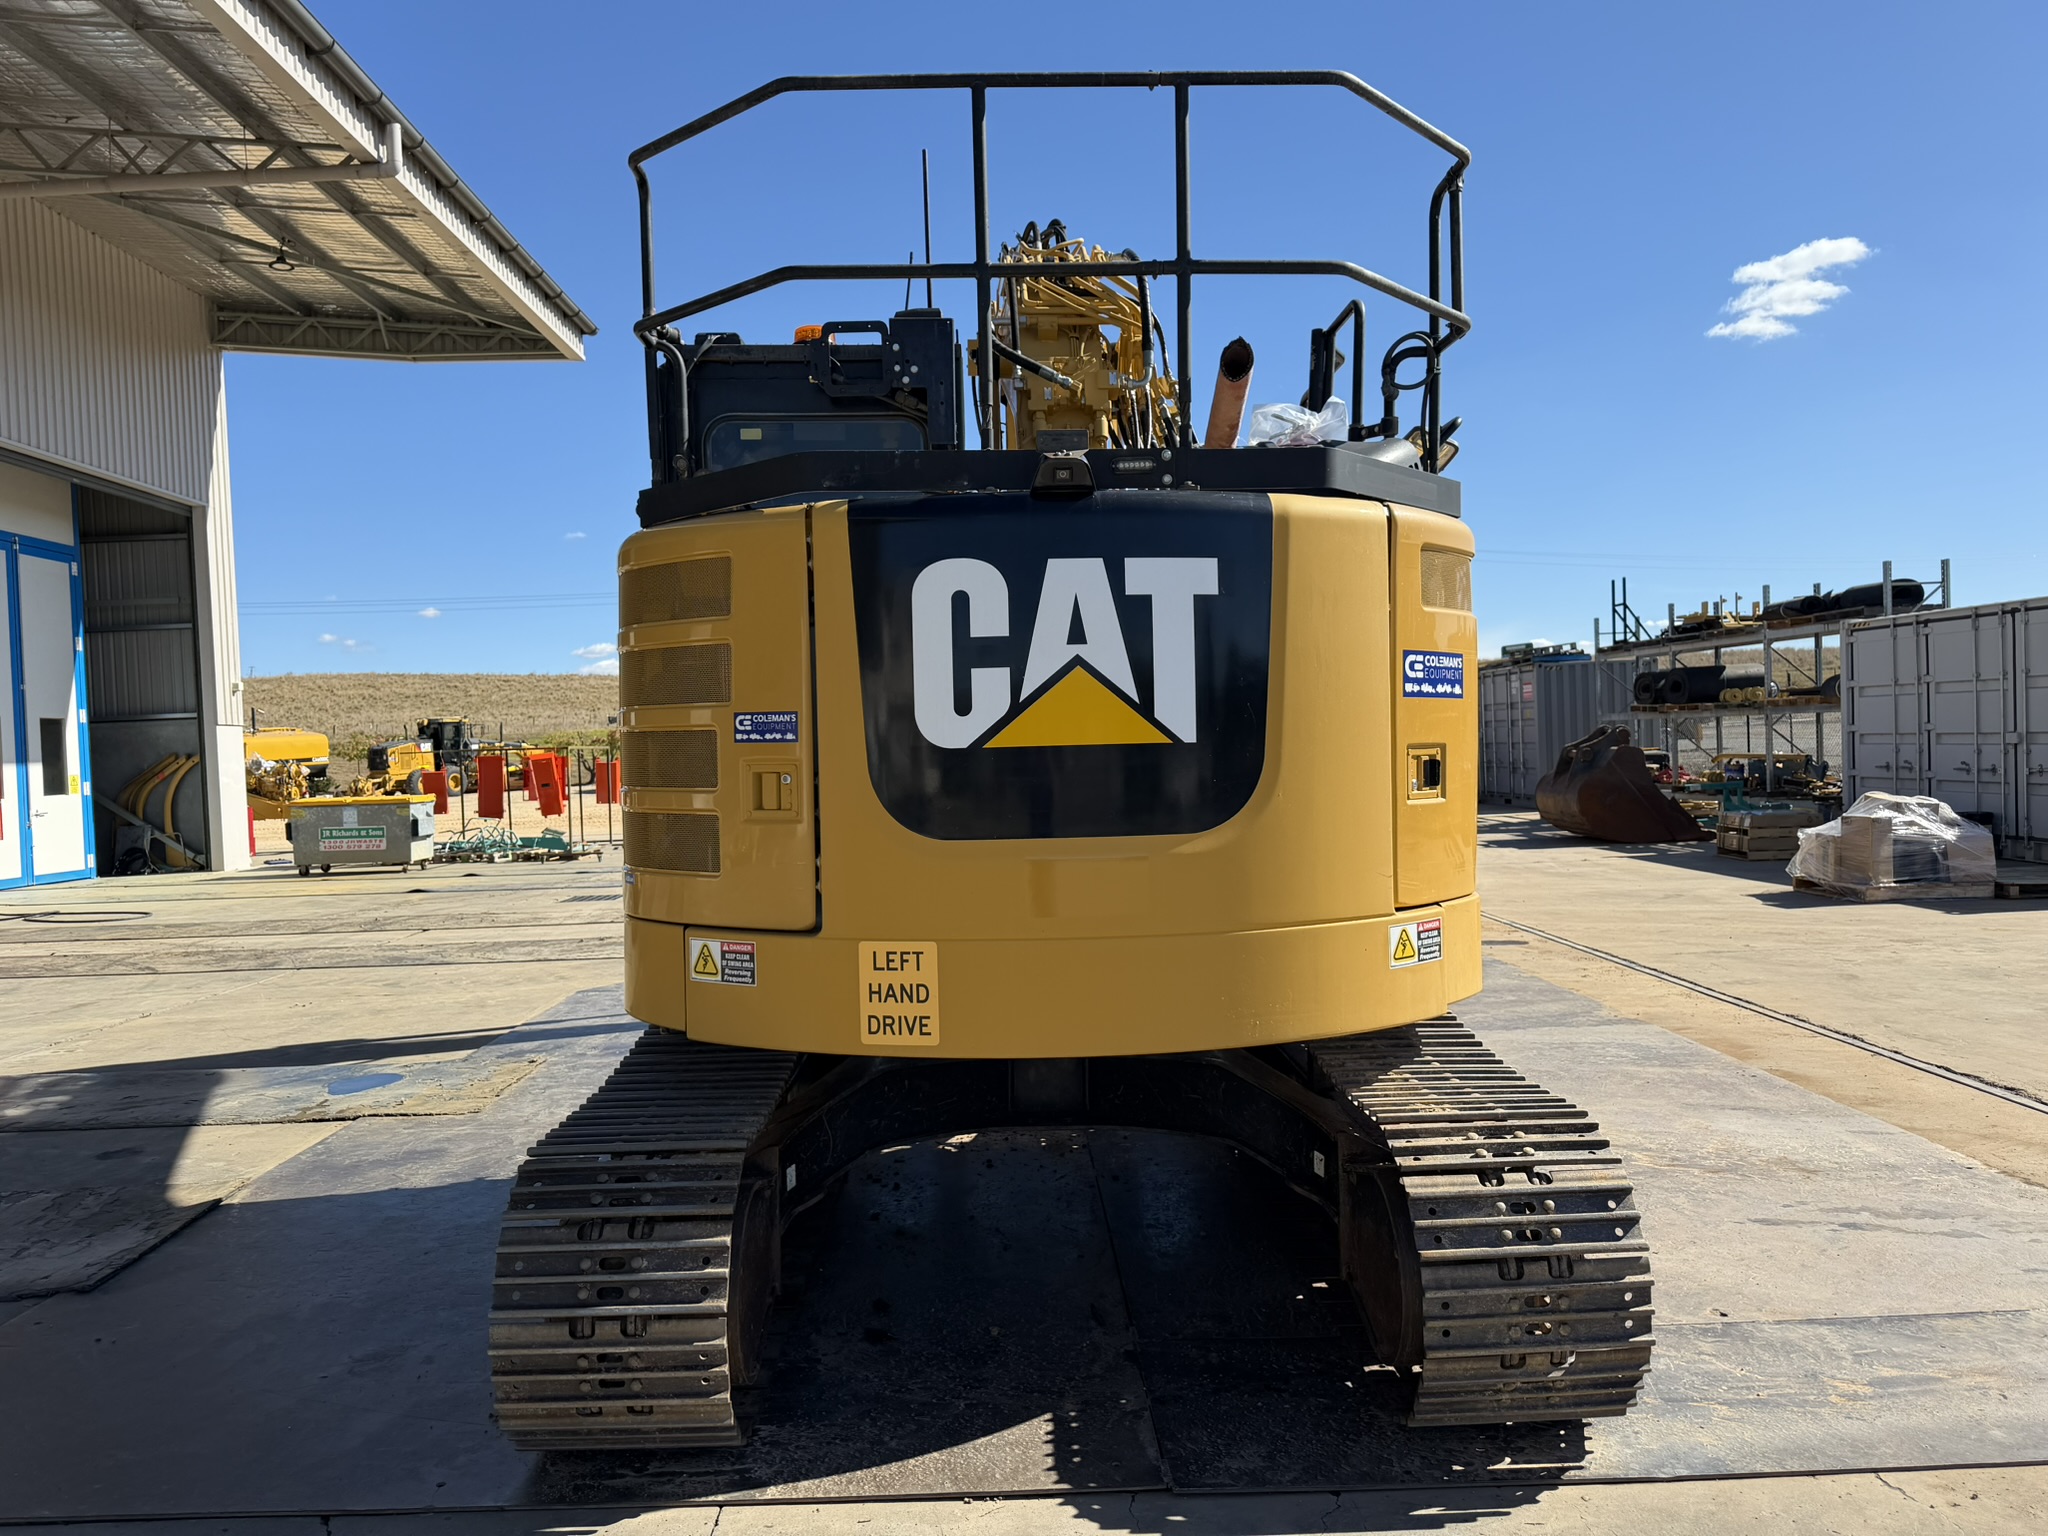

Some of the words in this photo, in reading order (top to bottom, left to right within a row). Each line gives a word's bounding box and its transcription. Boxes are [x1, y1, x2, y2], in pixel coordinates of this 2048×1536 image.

[912, 558, 1218, 748] CAT
[1425, 655, 1462, 668] COLEMAN'S
[1425, 668, 1462, 680] EQUIPMENT
[753, 714, 796, 722] COLEMAN'S
[873, 951, 924, 971] LEFT
[725, 968, 751, 976] Reversing
[869, 983, 930, 1003] HAND
[868, 1015, 932, 1036] DRIVE
